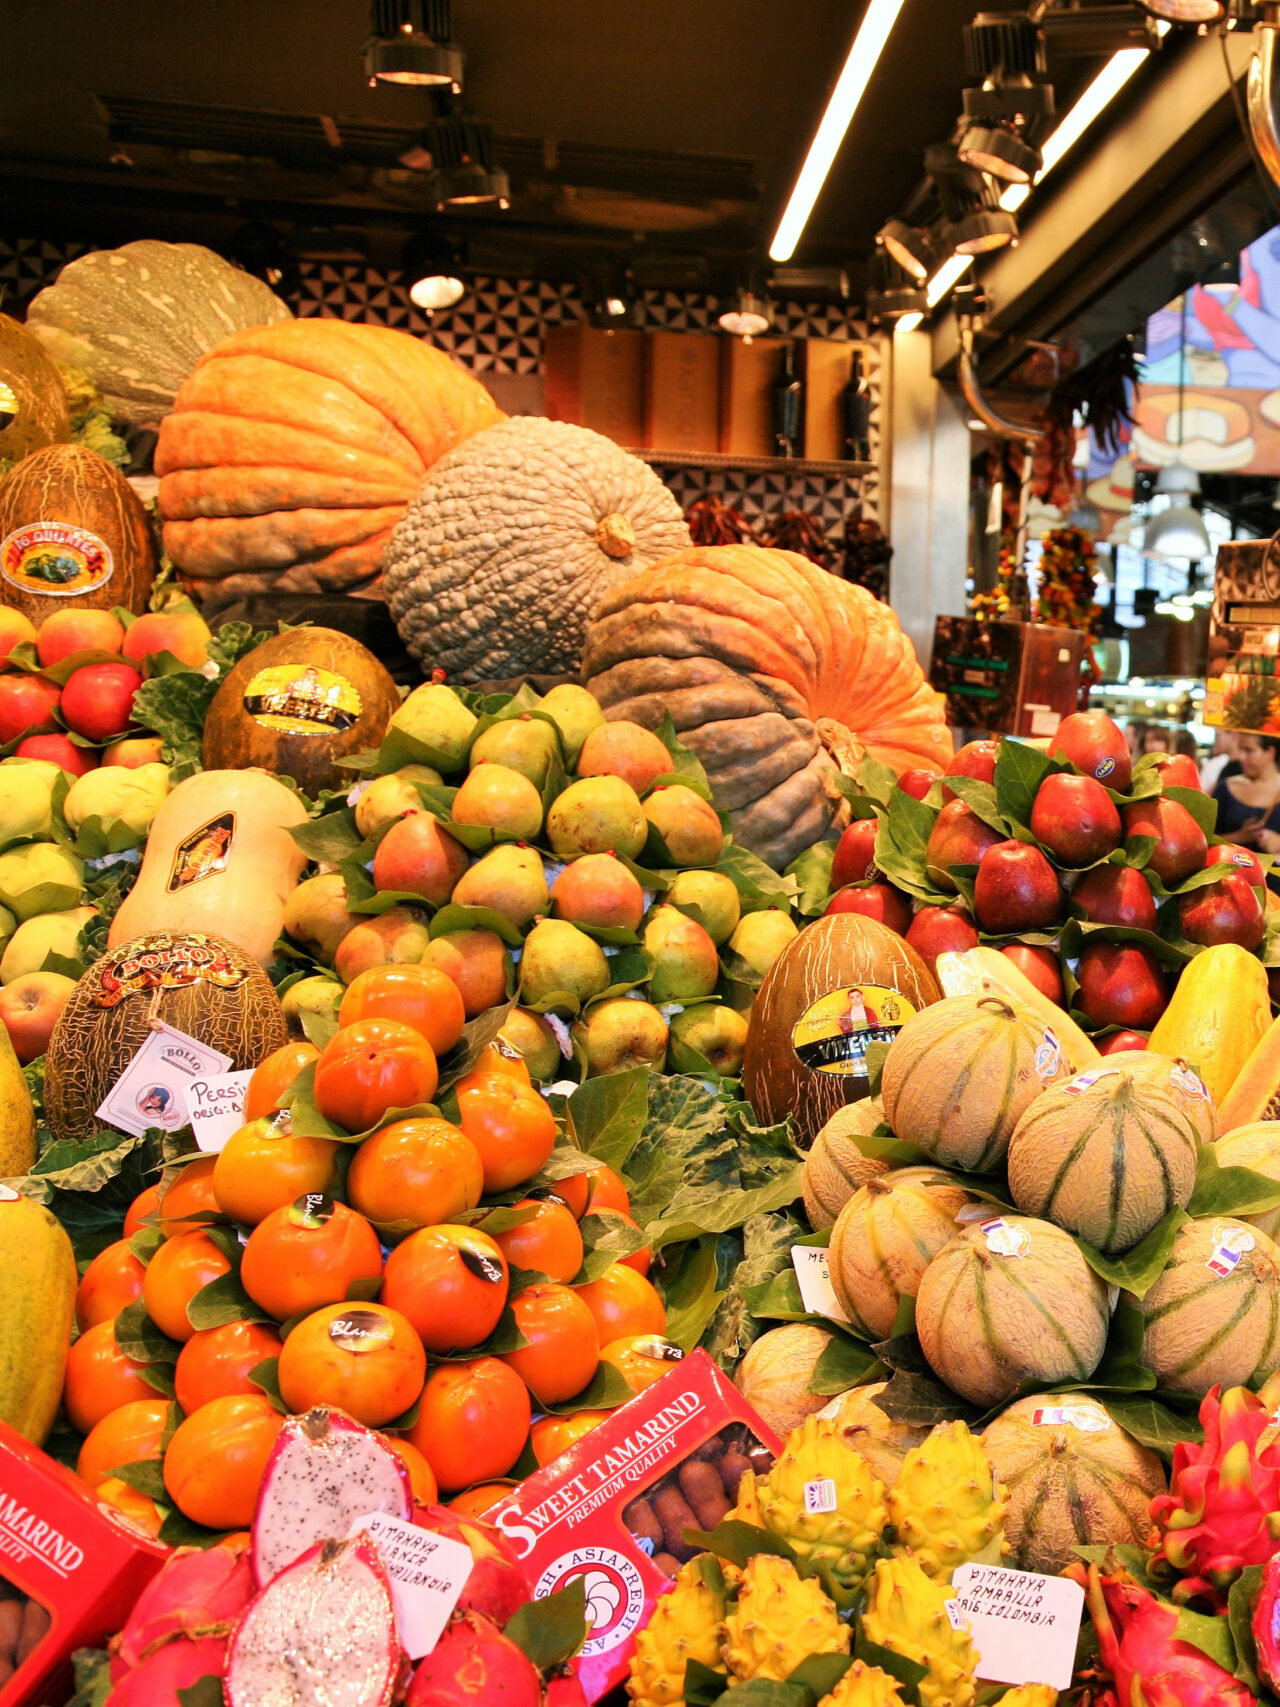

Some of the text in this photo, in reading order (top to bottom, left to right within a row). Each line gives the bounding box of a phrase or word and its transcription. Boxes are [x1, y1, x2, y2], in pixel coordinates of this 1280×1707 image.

[122, 948, 209, 976] BOLLO
[167, 1048, 202, 1072] BOLLO
[329, 1320, 389, 1340] Blanca
[495, 1391, 701, 1560] SWEET TAMARIND
[566, 1435, 678, 1529] PREMIUM QUALITY
[571, 1548, 642, 1631] ASIAFRESH
